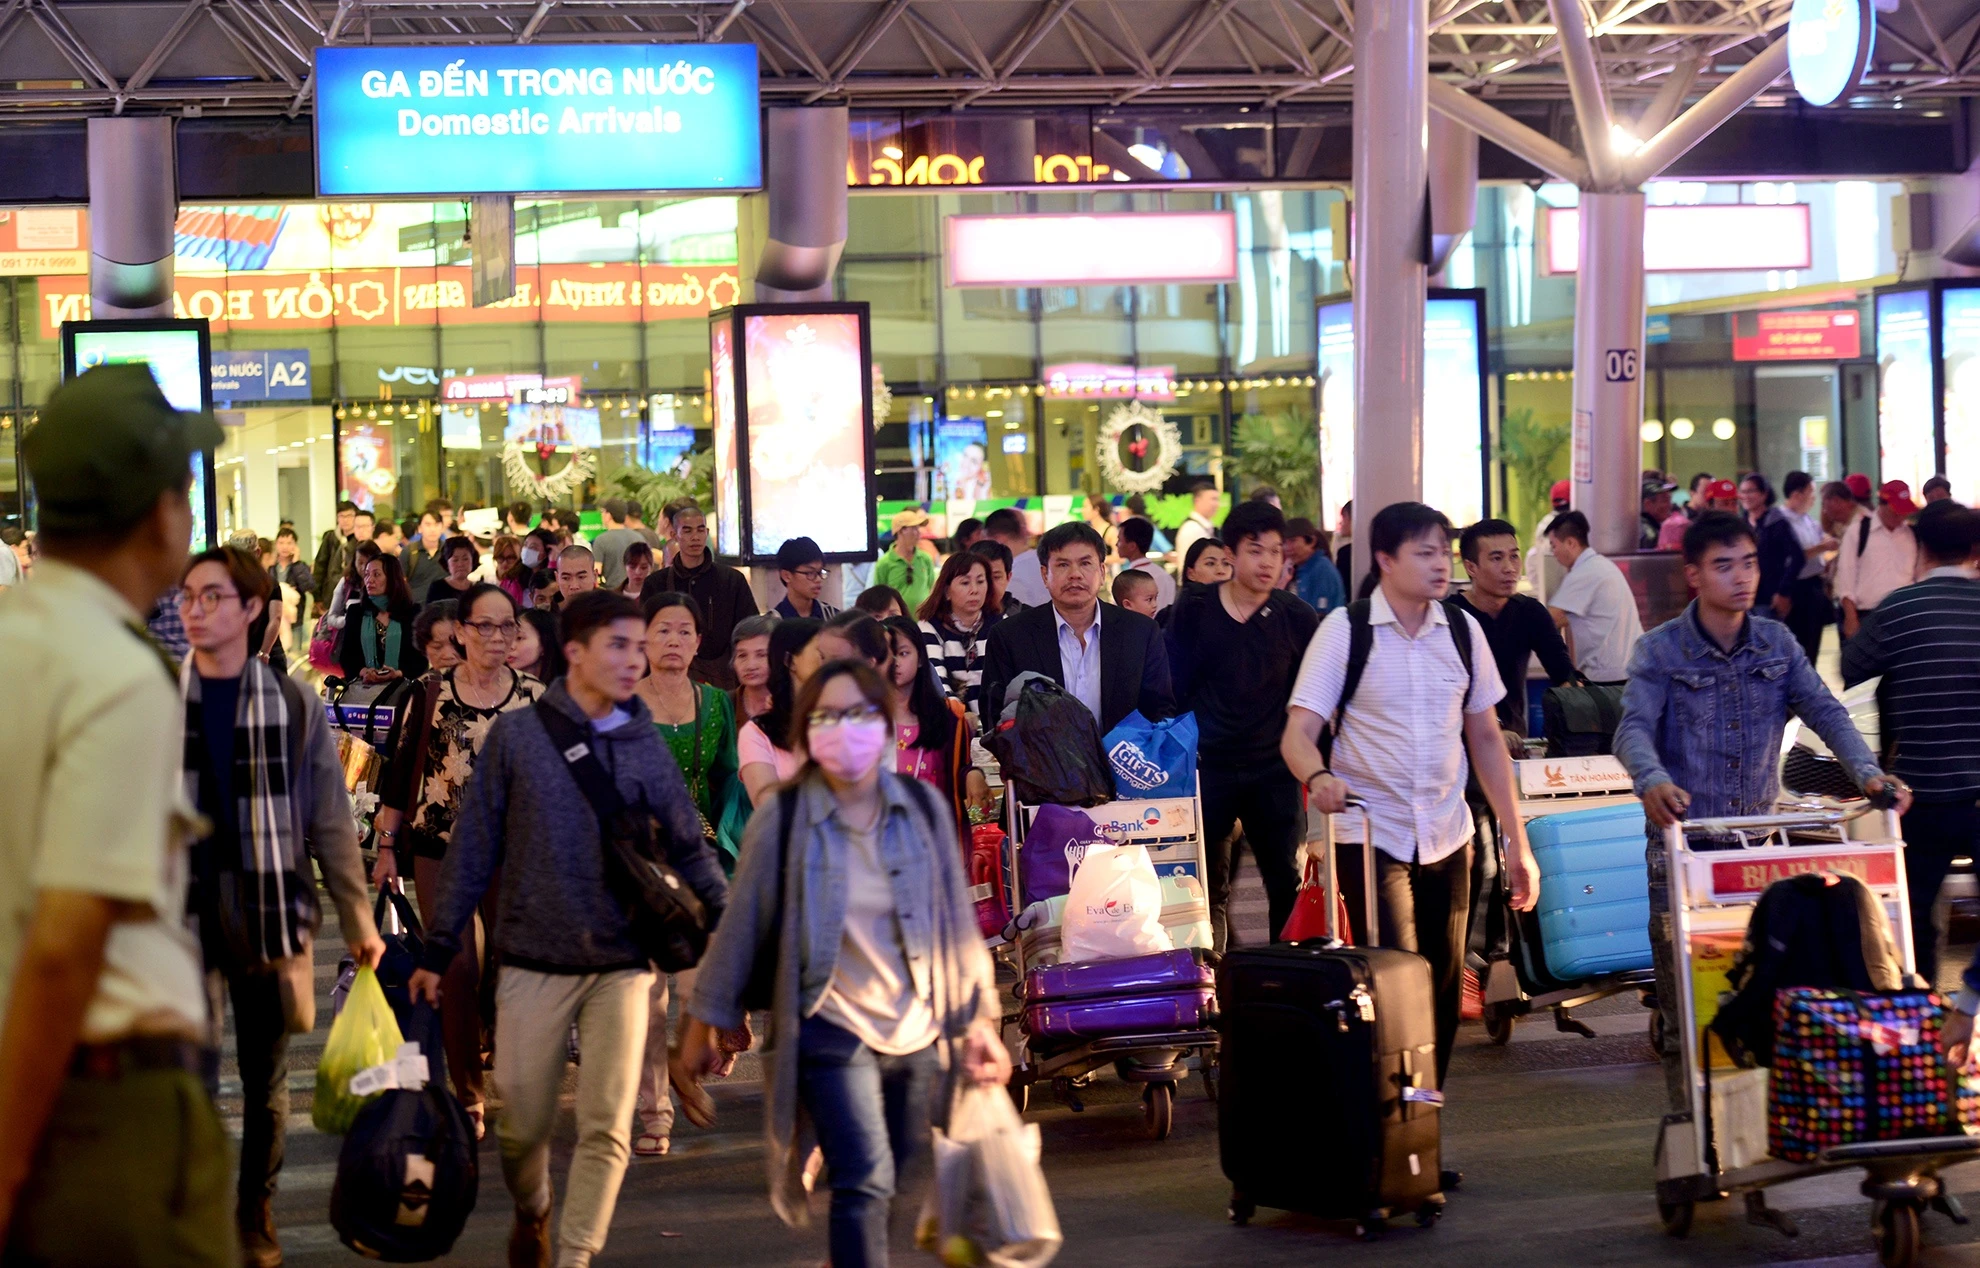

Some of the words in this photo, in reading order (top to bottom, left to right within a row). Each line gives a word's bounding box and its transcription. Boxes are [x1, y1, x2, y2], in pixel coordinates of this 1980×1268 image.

[361, 70, 411, 98] GA
[418, 59, 489, 98] ĐẾN
[497, 66, 613, 96] TRONG
[623, 60, 715, 95] NƯỚC
[398, 108, 549, 136] Domestic
[558, 105, 681, 134] Arrivals
[25, 257, 45, 267] 774
[270, 361, 307, 387] A2
[1607, 351, 1636, 380] 06
[1118, 749, 1164, 783] GIFTS
[1099, 819, 1145, 834] nBank
[1742, 863, 1783, 888] BIA
[1086, 906, 1104, 915] Eva
